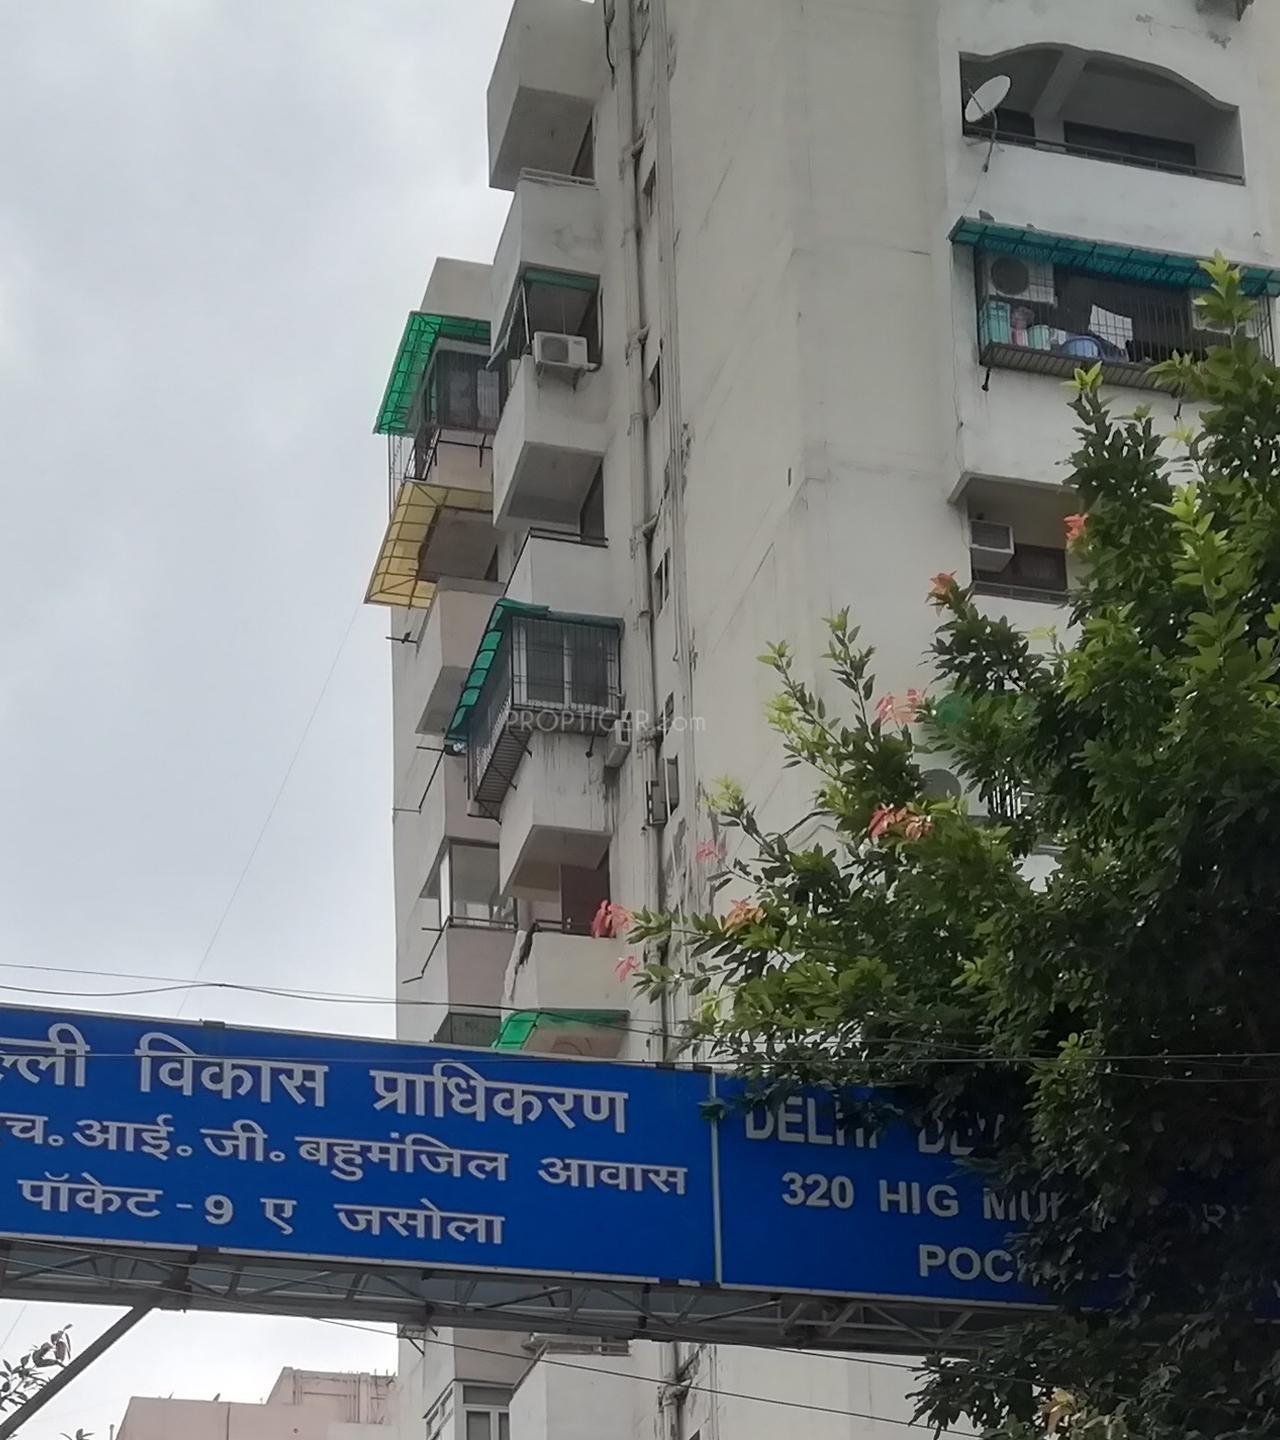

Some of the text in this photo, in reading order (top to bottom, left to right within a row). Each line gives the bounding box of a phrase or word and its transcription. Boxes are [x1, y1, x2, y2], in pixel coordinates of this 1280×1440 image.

[134, 1031, 329, 1108] विकास
[368, 1058, 629, 1134] प्राधिकरण
[294, 1131, 510, 1182] बहुमंजिल
[537, 1156, 689, 1196] आवास
[260, 1197, 298, 1236] ए
[333, 1197, 507, 1245] जसोला
[781, 1171, 855, 1209] 320
[878, 1179, 960, 1218] HIG
